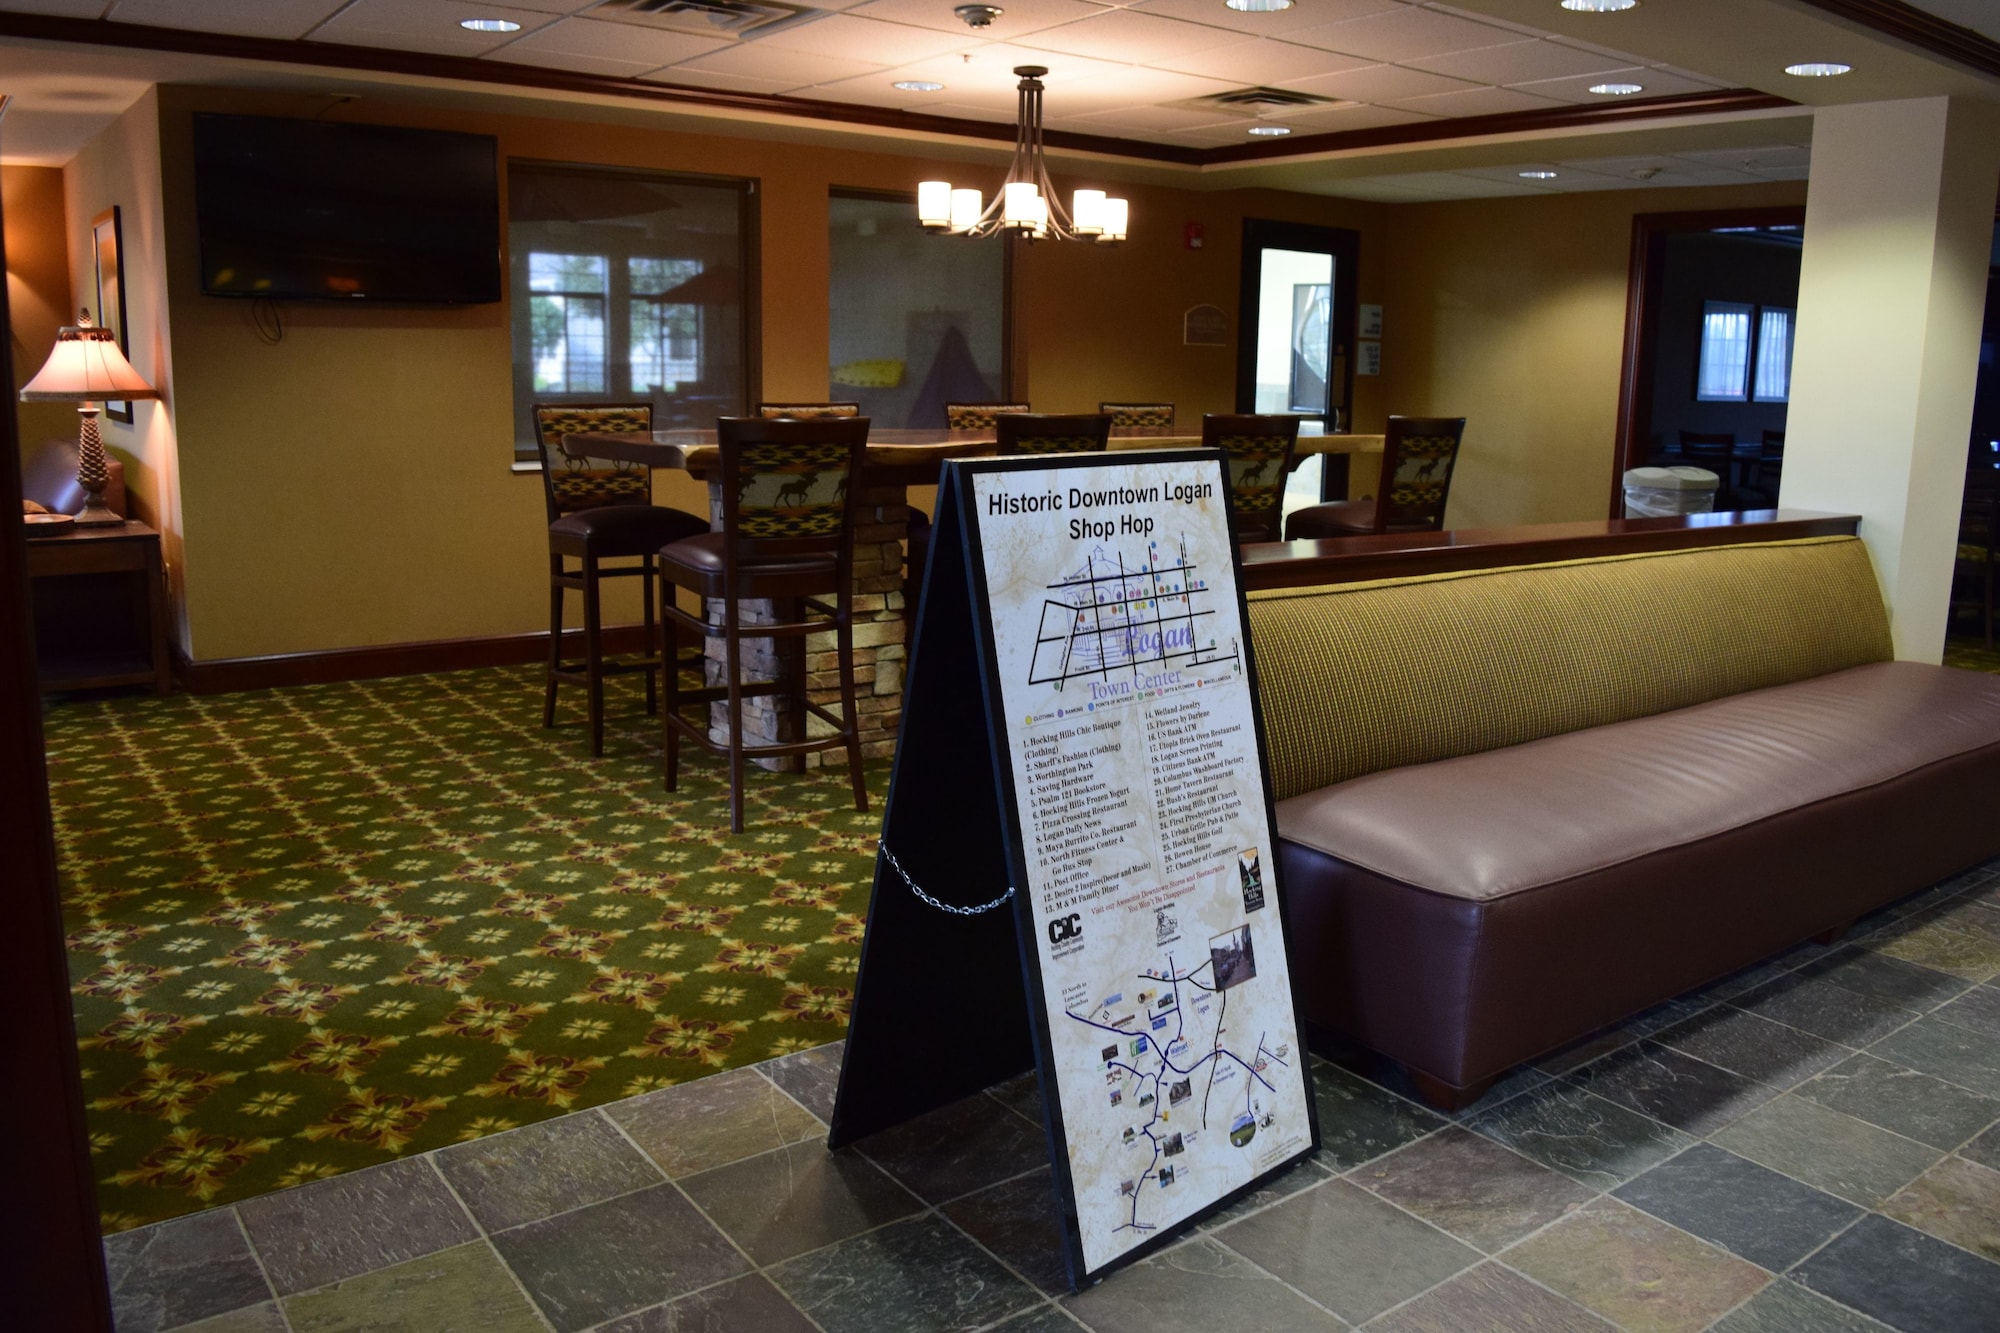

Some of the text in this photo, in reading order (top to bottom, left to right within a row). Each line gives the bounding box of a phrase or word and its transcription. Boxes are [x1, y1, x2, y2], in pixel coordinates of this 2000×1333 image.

[989, 482, 1211, 514] Historic Downtown Logan
[1070, 514, 1153, 541] Shop Hop
[1122, 620, 1192, 659] Logan
[1087, 666, 1181, 699] Town Center
[1065, 706, 1083, 714] BANKING
[1179, 701, 1200, 711] Jewelry
[1155, 718, 1179, 728] Flowers
[1179, 714, 1186, 723] by
[1187, 711, 1209, 720] Darlene
[1157, 730, 1166, 739] US
[1167, 726, 1182, 736] Bank
[1184, 723, 1196, 732] ATM
[1030, 734, 1058, 746] Hocking
[1059, 729, 1075, 739] Hills
[1076, 726, 1091, 735] Chic
[1092, 720, 1120, 732] Boutique
[1158, 740, 1178, 750] Utopia
[1179, 734, 1195, 745] Brick
[1195, 732, 1210, 740] Oven
[1210, 724, 1240, 737] Restaurant
[1024, 745, 1058, 760] (Clothing)
[1062, 751, 1088, 763] Fashion
[1089, 742, 1121, 757] (Clothing)
[1160, 751, 1178, 761] Logan
[1179, 746, 1199, 756] Screen
[1199, 740, 1223, 751] Printing
[1161, 761, 1185, 772] Citizens
[1186, 755, 1201, 765] Bank
[1203, 751, 1215, 760] ATM
[1034, 766, 1076, 780] Worthington
[1077, 760, 1093, 771] Park
[1163, 770, 1192, 783] Columbus
[1192, 760, 1223, 774] Washboard
[1224, 756, 1243, 766] Factory
[1164, 784, 1181, 794] Home
[1182, 778, 1202, 789] Tavern
[1203, 769, 1233, 783] Restaurant
[1037, 782, 1060, 793] Saving
[1061, 774, 1093, 787] Hardware
[1038, 794, 1059, 805] Psalm
[1061, 790, 1072, 799] 121
[1073, 783, 1105, 796] Bookstore
[1186, 784, 1218, 799] Restaurant
[1040, 804, 1068, 817] Hocking
[1069, 799, 1085, 809] Hills
[1086, 794, 1108, 805] Frozen
[1109, 787, 1129, 798] Yogurt
[1041, 819, 1060, 829] Pizza
[1061, 810, 1091, 823] Crossing
[1092, 799, 1127, 815] Restaurant
[1168, 804, 1192, 815] Hocking
[1192, 798, 1206, 808] Hills
[1206, 795, 1216, 804] UM
[1217, 789, 1237, 801] Church
[1169, 817, 1184, 826] First
[1184, 806, 1220, 822] Presbyterian
[1221, 799, 1241, 810] Church
[1043, 830, 1064, 841] Logan
[1065, 824, 1082, 834] Daily
[1084, 820, 1101, 829] News
[1045, 842, 1063, 852] Maya
[1064, 835, 1089, 847] Burrito
[1090, 831, 1100, 839] Co.
[1101, 820, 1136, 836] Restaurant
[1170, 827, 1189, 838] Urban
[1206, 817, 1218, 826] Pub
[1224, 811, 1238, 821] Patio
[1172, 836, 1196, 848] Hocking
[1196, 831, 1210, 840] Hills
[1211, 826, 1223, 836] Golf
[1050, 851, 1069, 863] North
[1071, 845, 1095, 857] Fitness
[1096, 838, 1117, 849] Center
[1173, 848, 1193, 859] Bowen
[1193, 843, 1211, 853] House
[1175, 857, 1200, 870] Chamber
[1202, 853, 1208, 861] of
[1208, 845, 1237, 859] Commerce
[1052, 858, 1092, 875] Go Bus Stop
[1054, 876, 1068, 887] Post
[1069, 871, 1089, 881] Office
[1054, 887, 1074, 899] Desire
[1074, 884, 1079, 892] 2
[1120, 867, 1131, 877] and
[1132, 861, 1151, 872] Music)
[1090, 864, 1225, 914] Visit our Awesome Downtown Stores and Restaurants
[1078, 889, 1099, 902] Family
[1101, 884, 1119, 894] Diner
[1138, 898, 1154, 909] Won't
[1163, 883, 1195, 900] Disappointed
